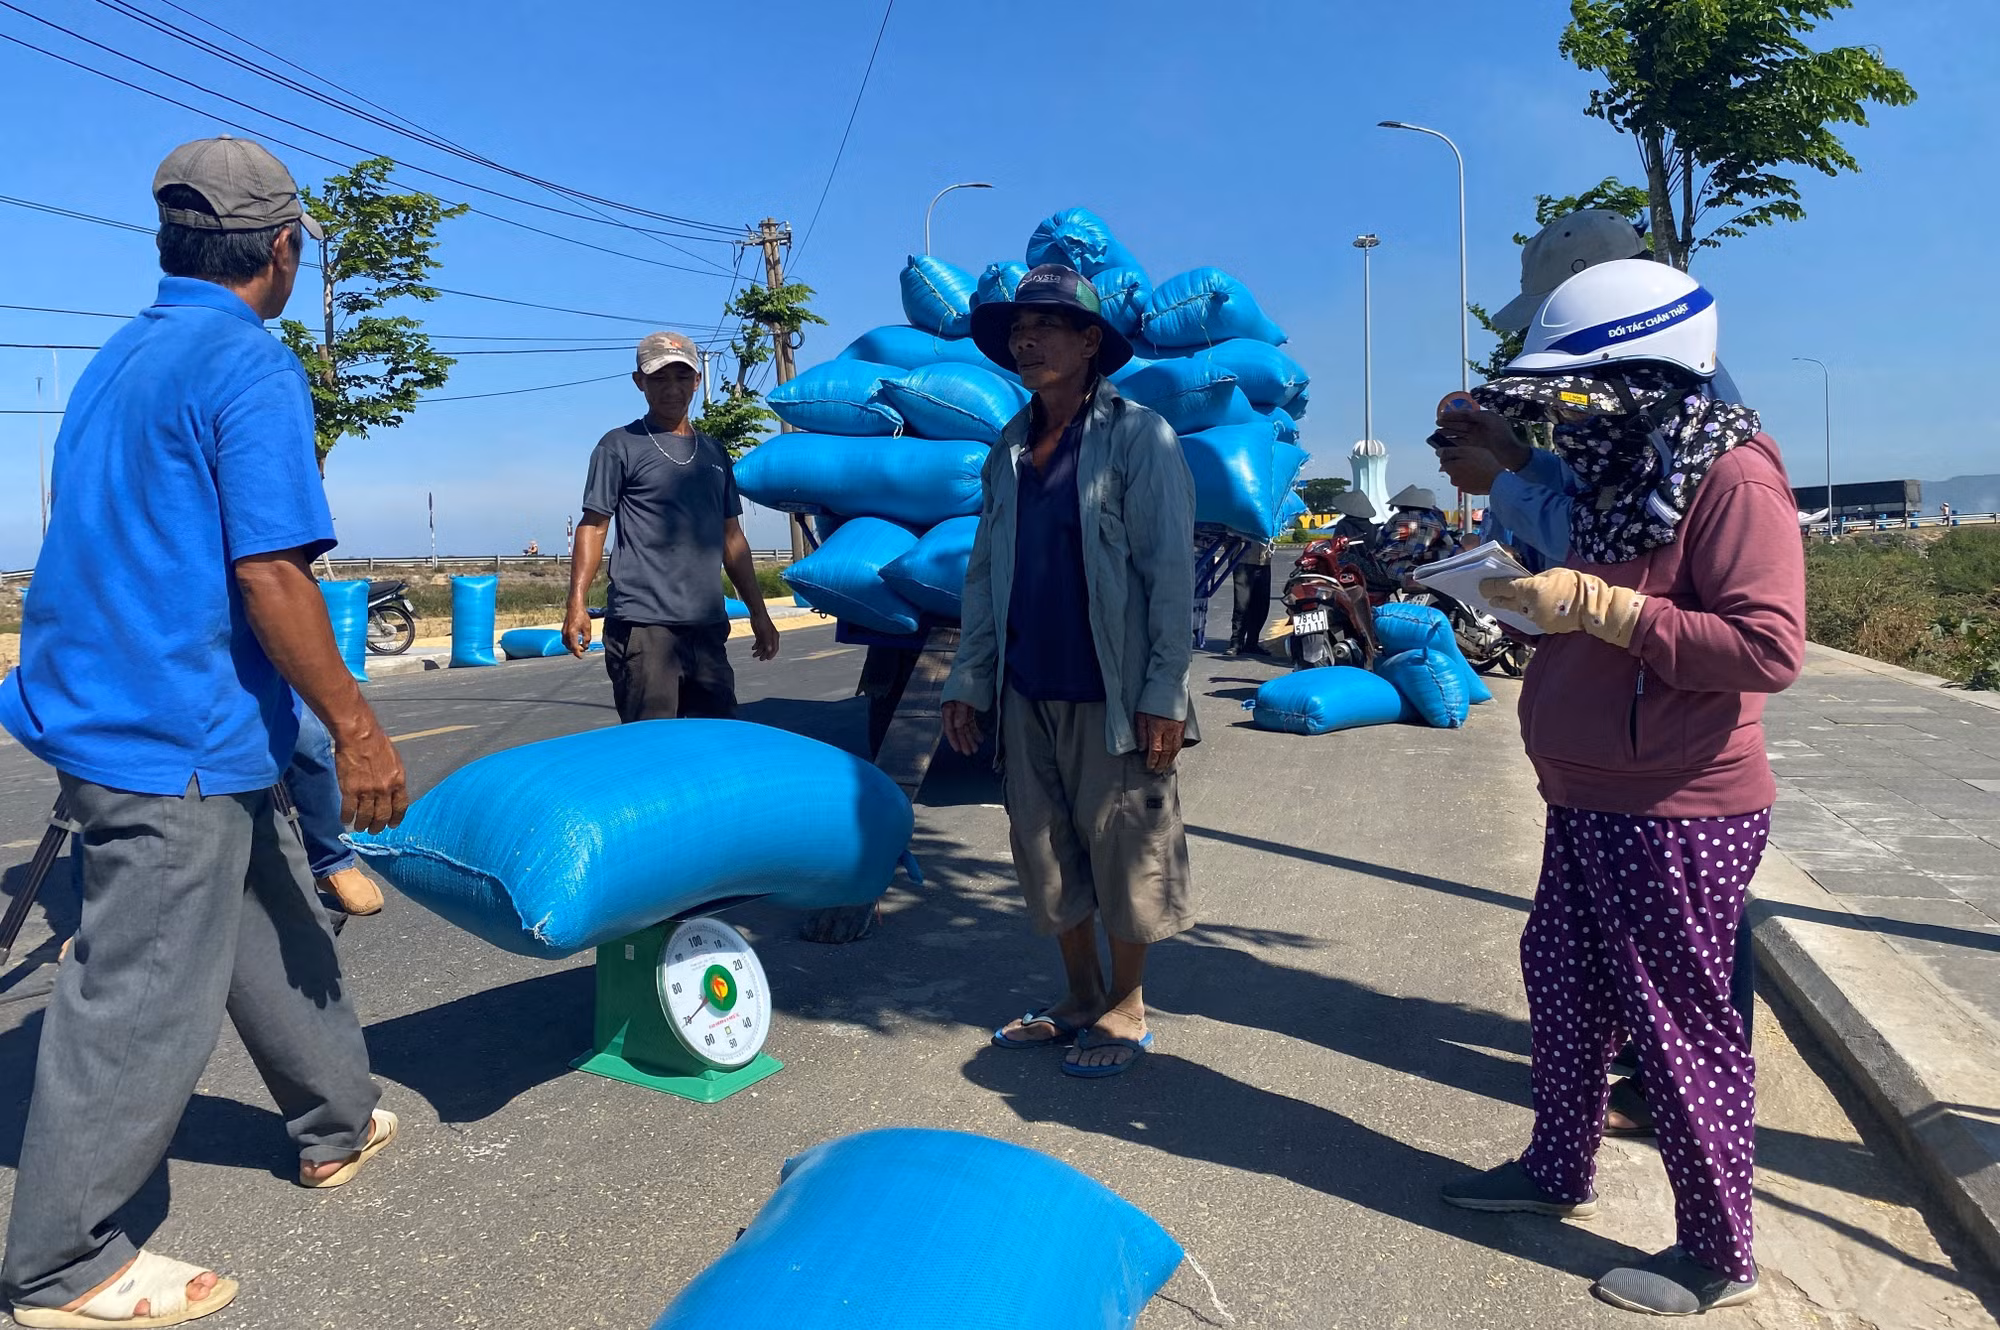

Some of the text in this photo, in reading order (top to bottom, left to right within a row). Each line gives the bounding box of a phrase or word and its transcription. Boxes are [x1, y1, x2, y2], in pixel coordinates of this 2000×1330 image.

[1608, 303, 1689, 338] ĐỐI TÁC CHÂN THẬT
[688, 935, 703, 948] 100
[714, 939, 722, 949] 10
[733, 959, 743, 971] 20
[672, 982, 682, 995] 80
[746, 989, 754, 1000] 30
[742, 1016, 752, 1029] 40
[704, 1033, 715, 1046] 60
[729, 1038, 738, 1049] 50
